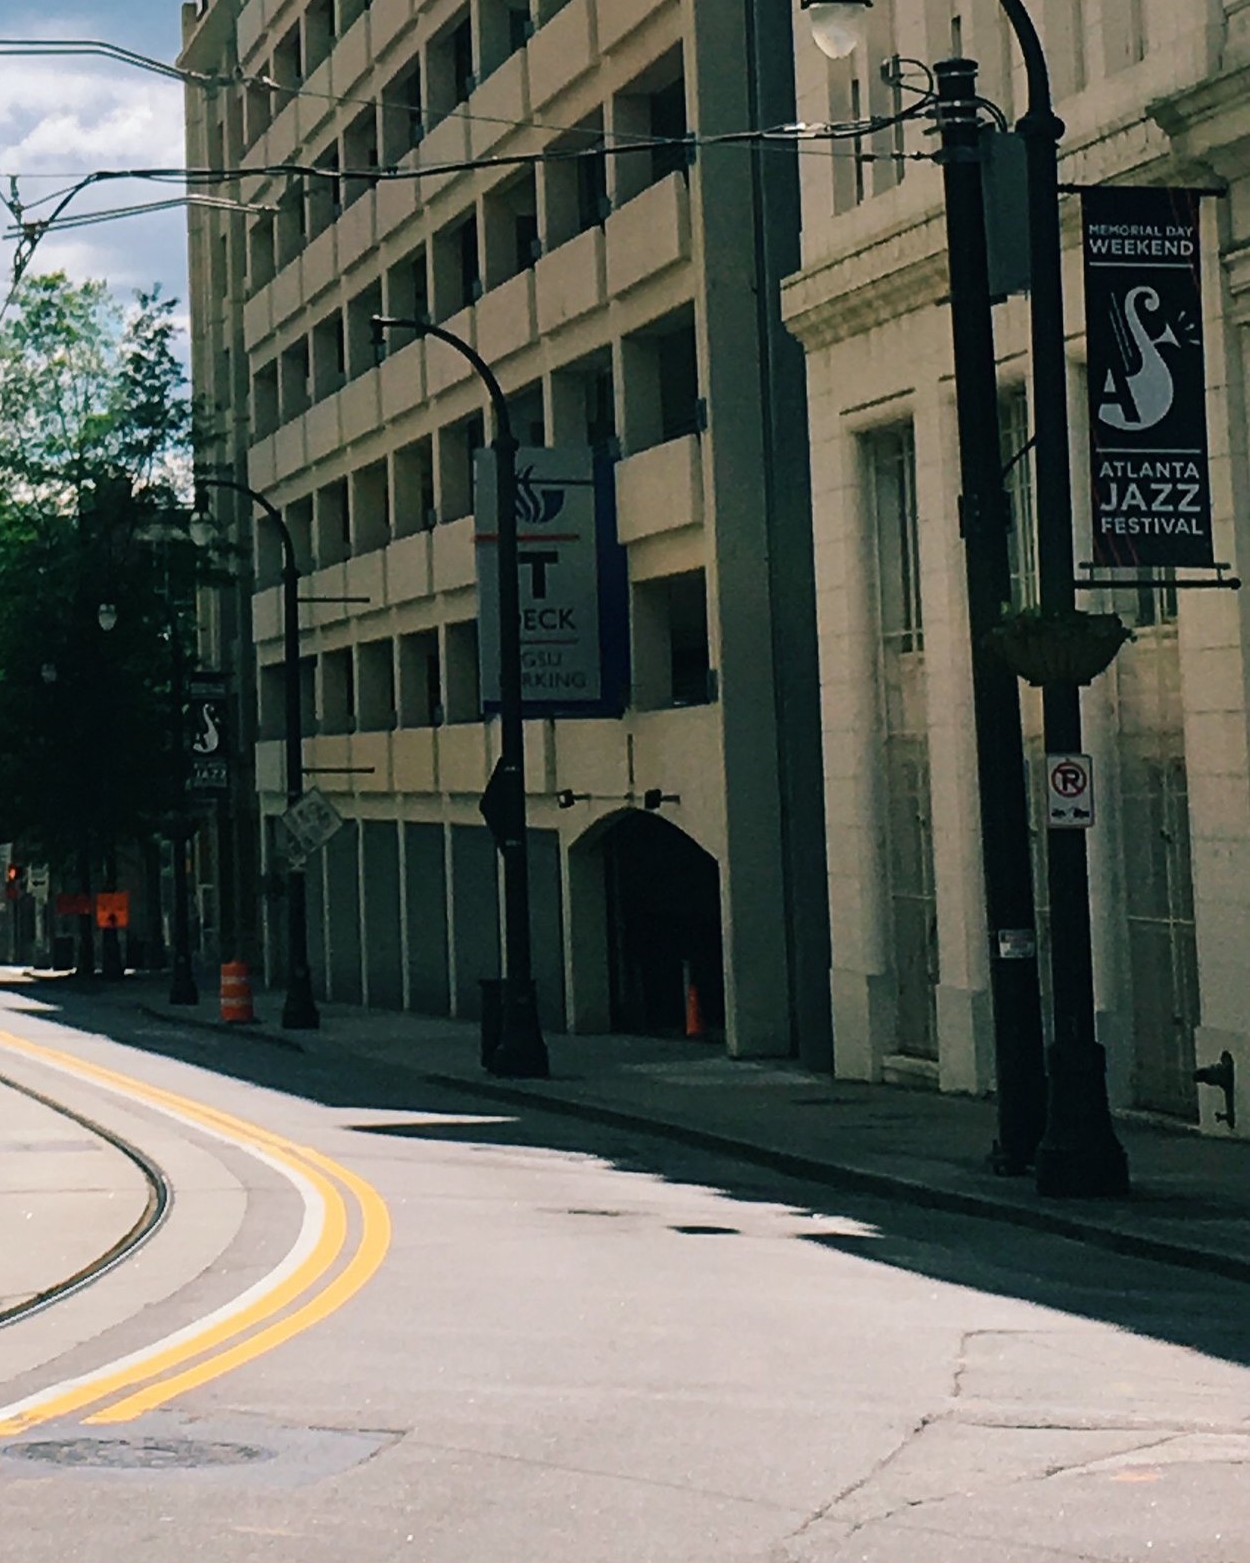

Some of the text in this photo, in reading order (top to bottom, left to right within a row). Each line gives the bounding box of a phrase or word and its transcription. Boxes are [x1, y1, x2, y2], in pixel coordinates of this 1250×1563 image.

[1089, 224, 1193, 237] MEMORIAL DAY
[1089, 239, 1194, 256] WEEKEND
[1099, 461, 1200, 479] ATLANTA
[1099, 482, 1201, 512] JAZZ
[1101, 517, 1204, 535] FESTIVAL
[517, 551, 559, 599] T
[519, 608, 577, 631] ECK
[521, 672, 587, 689] RKING
